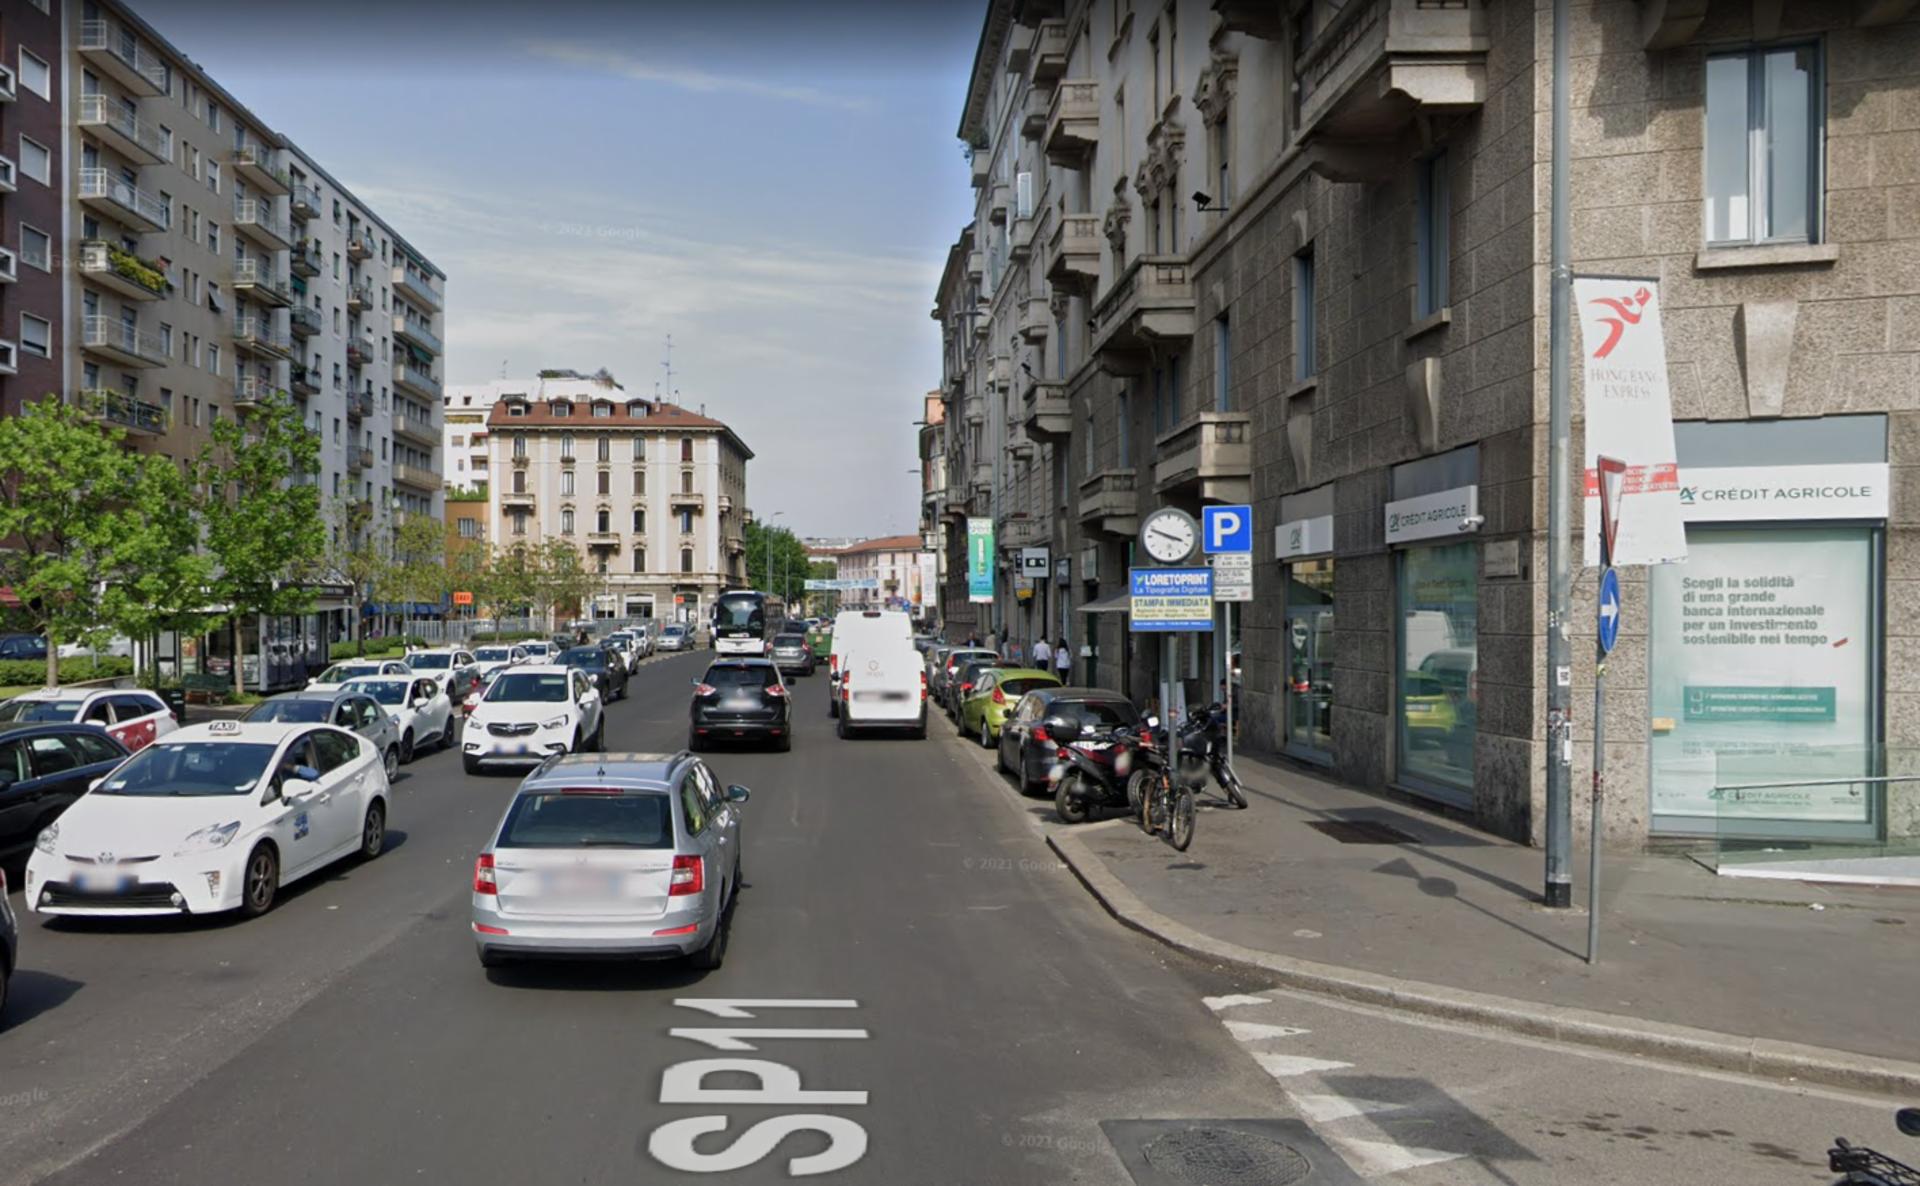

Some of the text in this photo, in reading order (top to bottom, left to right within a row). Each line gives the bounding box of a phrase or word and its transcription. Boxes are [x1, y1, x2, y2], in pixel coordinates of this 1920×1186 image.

[1701, 485, 1872, 501] CRÉDIT AGRICOLE
[1213, 511, 1241, 547] P
[1145, 573, 1208, 586] LORETOPRINT
[1682, 575, 1796, 591] Scegli la solidità
[1134, 598, 1210, 608] STAMPA IMMEDIATA
[1682, 591, 1776, 605] di una grande
[1682, 604, 1825, 616] banca internazionale
[1682, 619, 1819, 632] per un investimento
[1682, 633, 1756, 645] sostenibile
[1784, 633, 1829, 646] tempo
[209, 722, 236, 731] TAXI
[648, 998, 869, 1176] SP11
